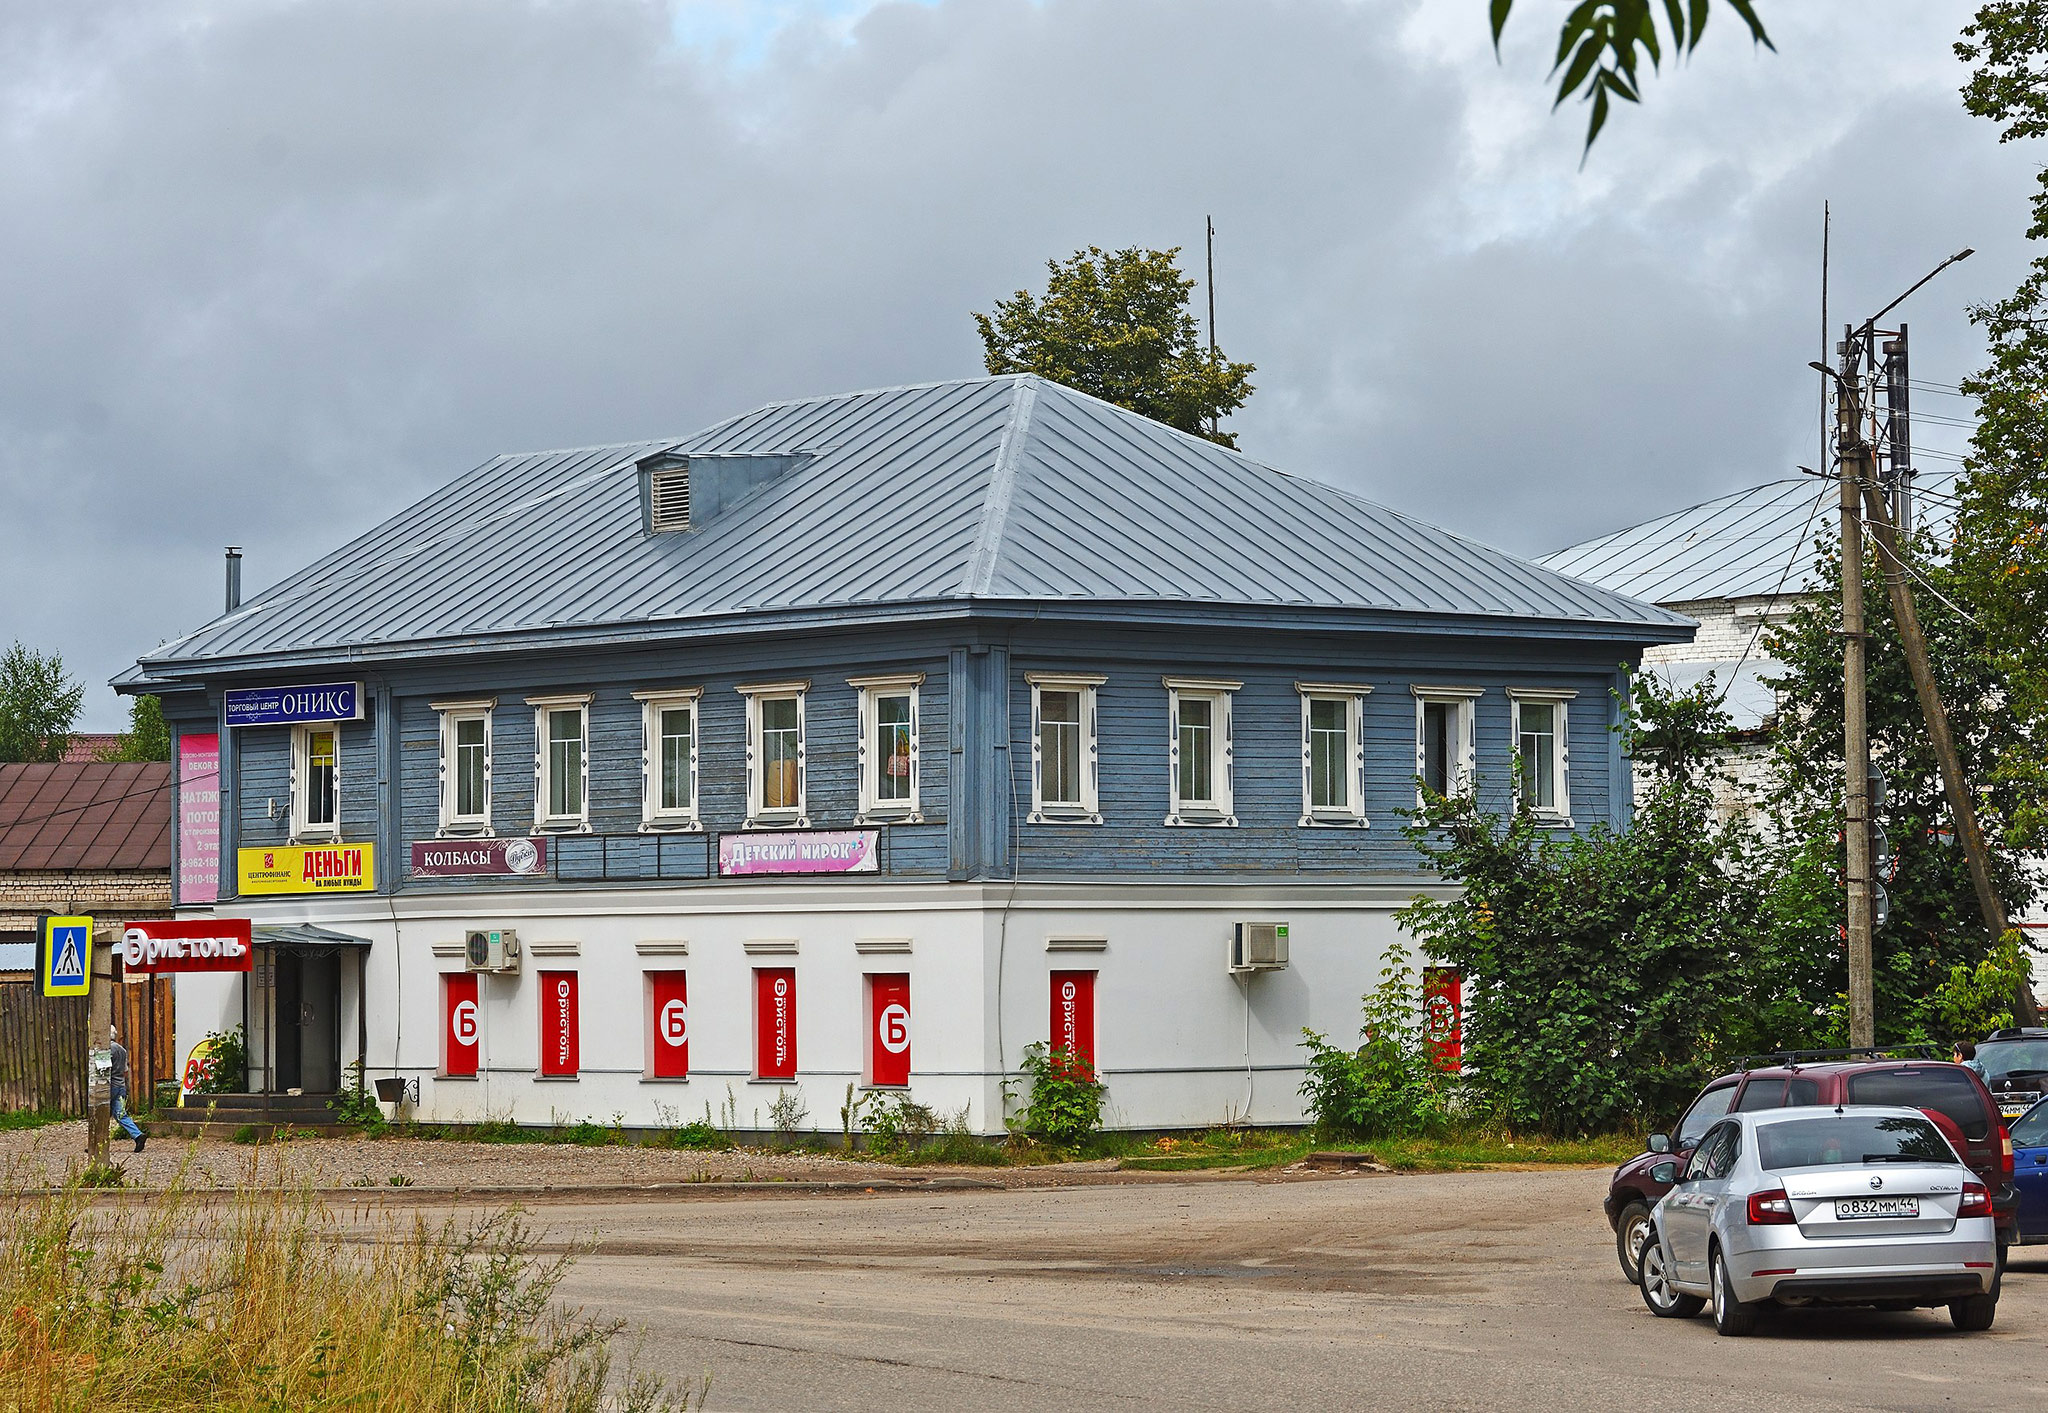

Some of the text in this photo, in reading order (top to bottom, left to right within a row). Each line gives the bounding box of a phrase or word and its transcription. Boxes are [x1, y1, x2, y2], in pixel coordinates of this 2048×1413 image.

[228, 701, 280, 713] ТОРГОВЫЙ ЦЕНТР
[282, 690, 350, 716] ОНИКС
[188, 761, 213, 770] DEKOR
[182, 790, 219, 804] НАТЯЖ
[197, 840, 203, 851] 2
[424, 850, 491, 867] КОЛБАСЫ
[303, 849, 362, 882] ДЕНЬГИ
[122, 928, 247, 966] Бристоль
[459, 1008, 477, 1038] Б
[558, 980, 570, 1066] Бристоль
[667, 1007, 686, 1038] Б
[774, 978, 787, 1068] Бристоль
[887, 1012, 907, 1044] Б
